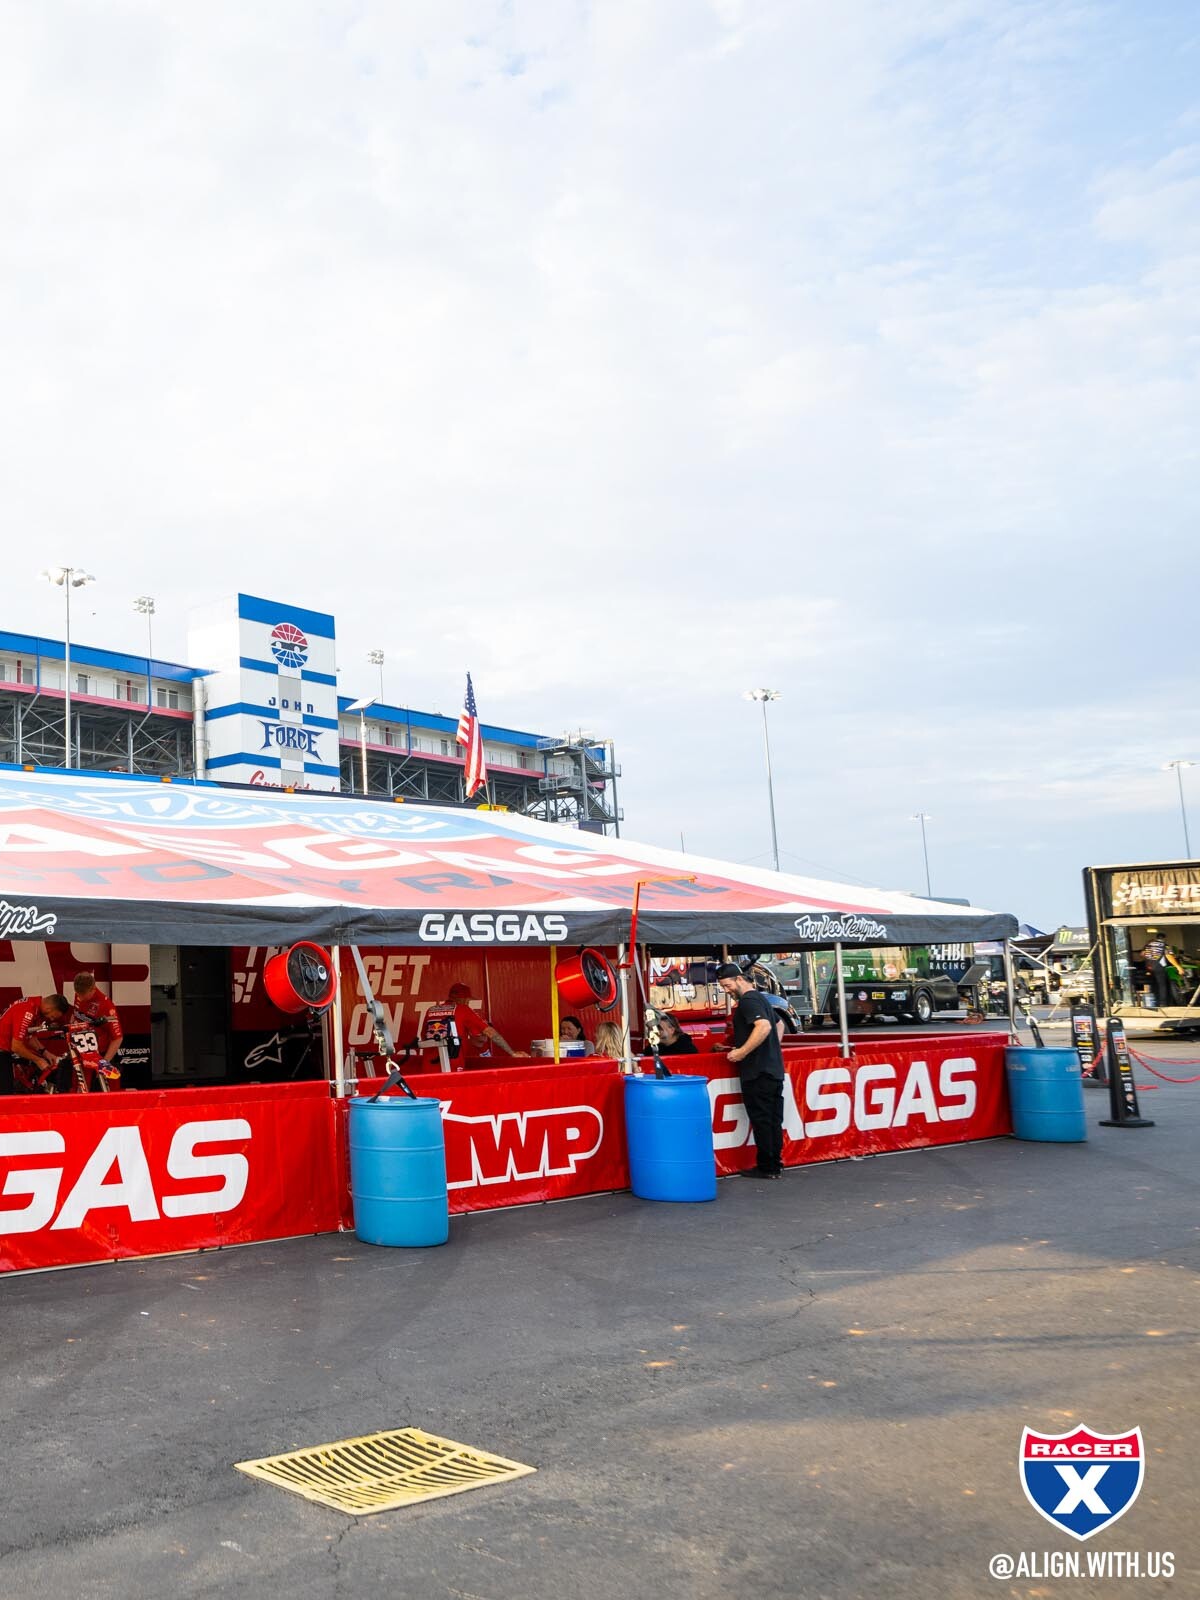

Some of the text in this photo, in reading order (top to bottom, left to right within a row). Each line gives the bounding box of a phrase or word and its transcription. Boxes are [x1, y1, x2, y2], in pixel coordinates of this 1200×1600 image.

[268, 696, 314, 714] JOHN
[257, 719, 324, 762] FORCE
[418, 913, 568, 942] GASGAS
[794, 913, 887, 942] Troy Lee Designs
[356, 955, 431, 998] GET
[929, 962, 966, 970] RACING
[74, 1032, 99, 1053] 33
